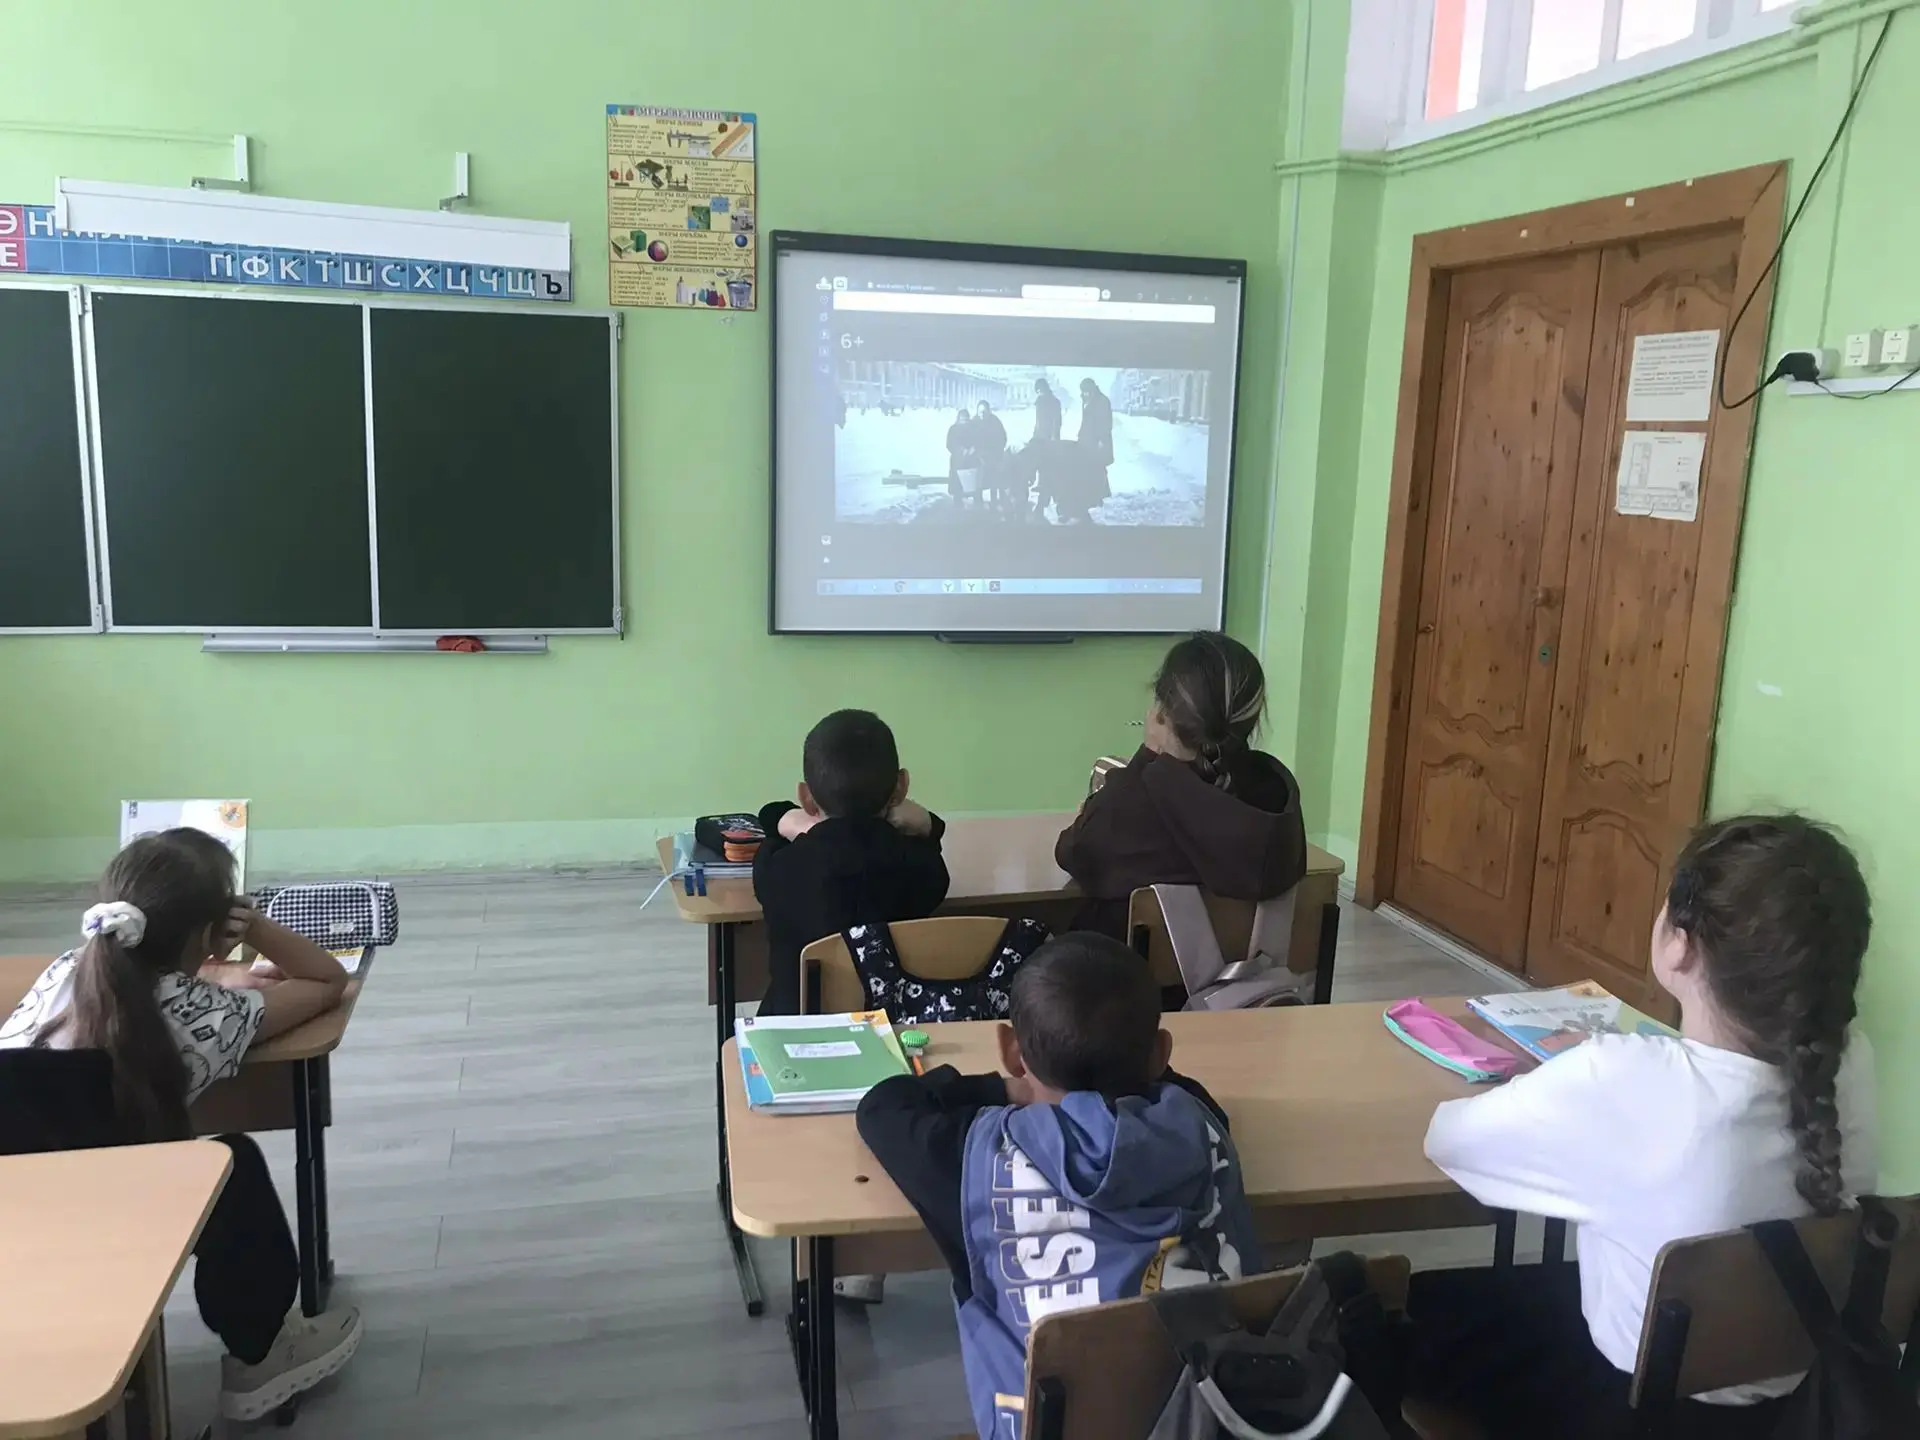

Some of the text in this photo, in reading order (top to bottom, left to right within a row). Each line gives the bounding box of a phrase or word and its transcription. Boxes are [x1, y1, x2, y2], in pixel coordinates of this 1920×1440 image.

[28, 211, 54, 236] Н
[0, 242, 563, 297] Е П Ф К Т Ш С Х Ц Ч Щ Ъ
[840, 333, 865, 349] 6+
